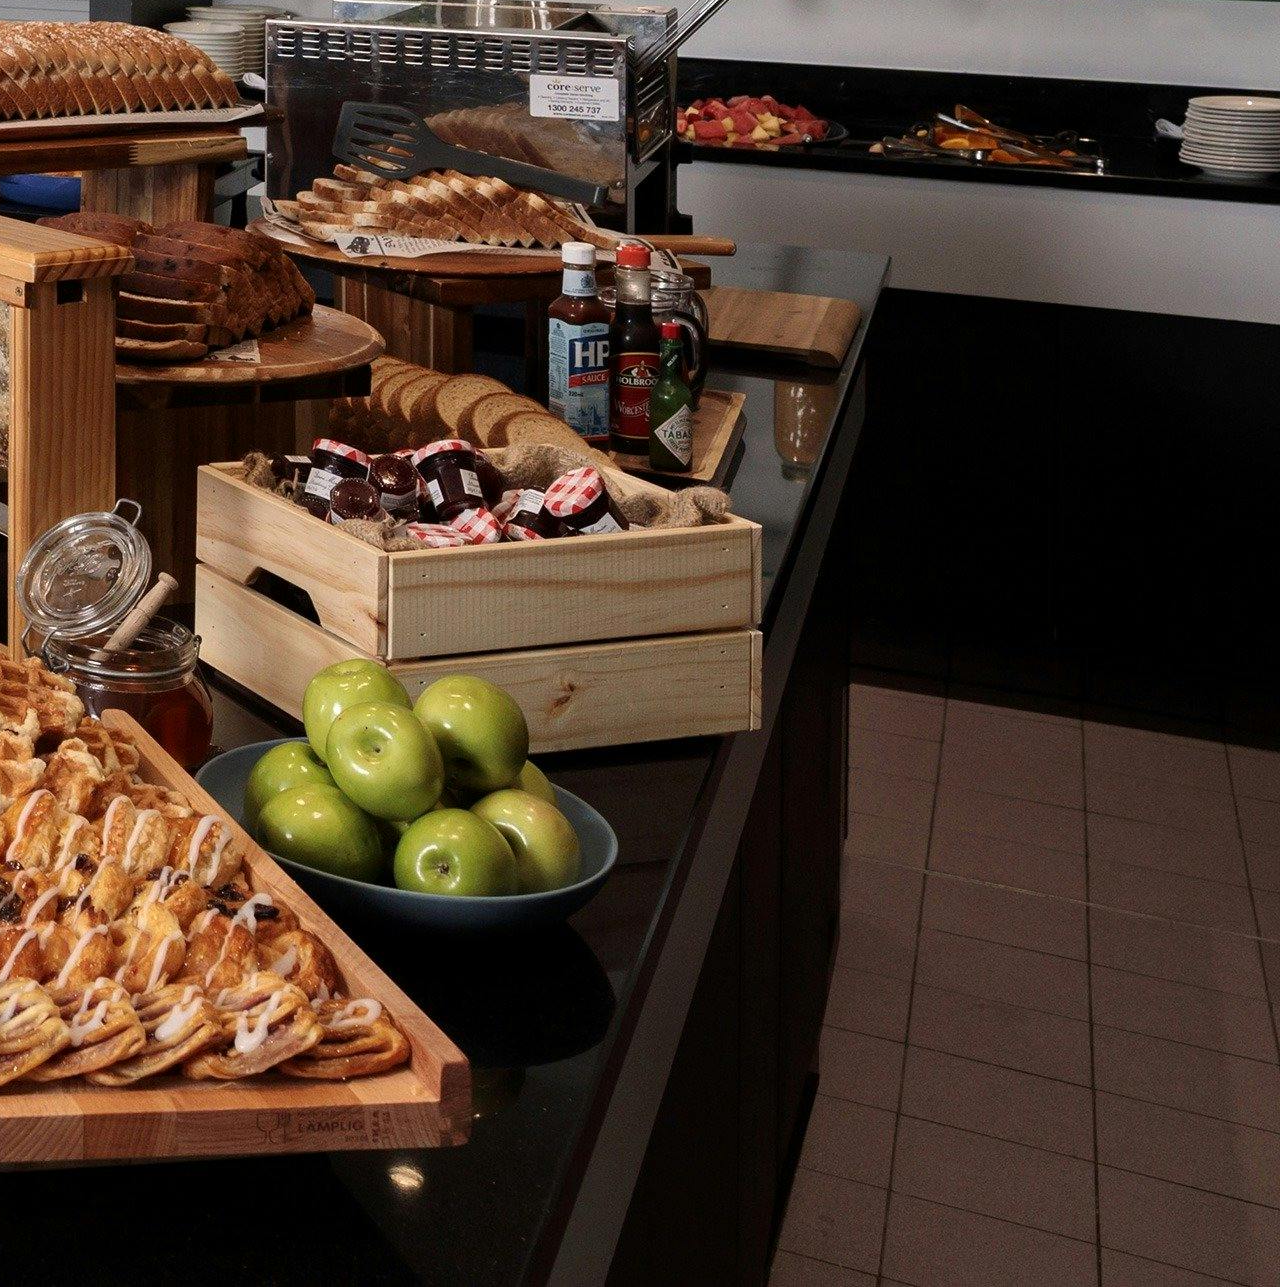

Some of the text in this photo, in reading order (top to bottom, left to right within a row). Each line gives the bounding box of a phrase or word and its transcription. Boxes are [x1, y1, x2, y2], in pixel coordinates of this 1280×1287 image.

[547, 83, 602, 93] core serve
[548, 104, 602, 114] 1300 245 737
[574, 340, 610, 368] HP
[581, 371, 607, 384] SAUCE
